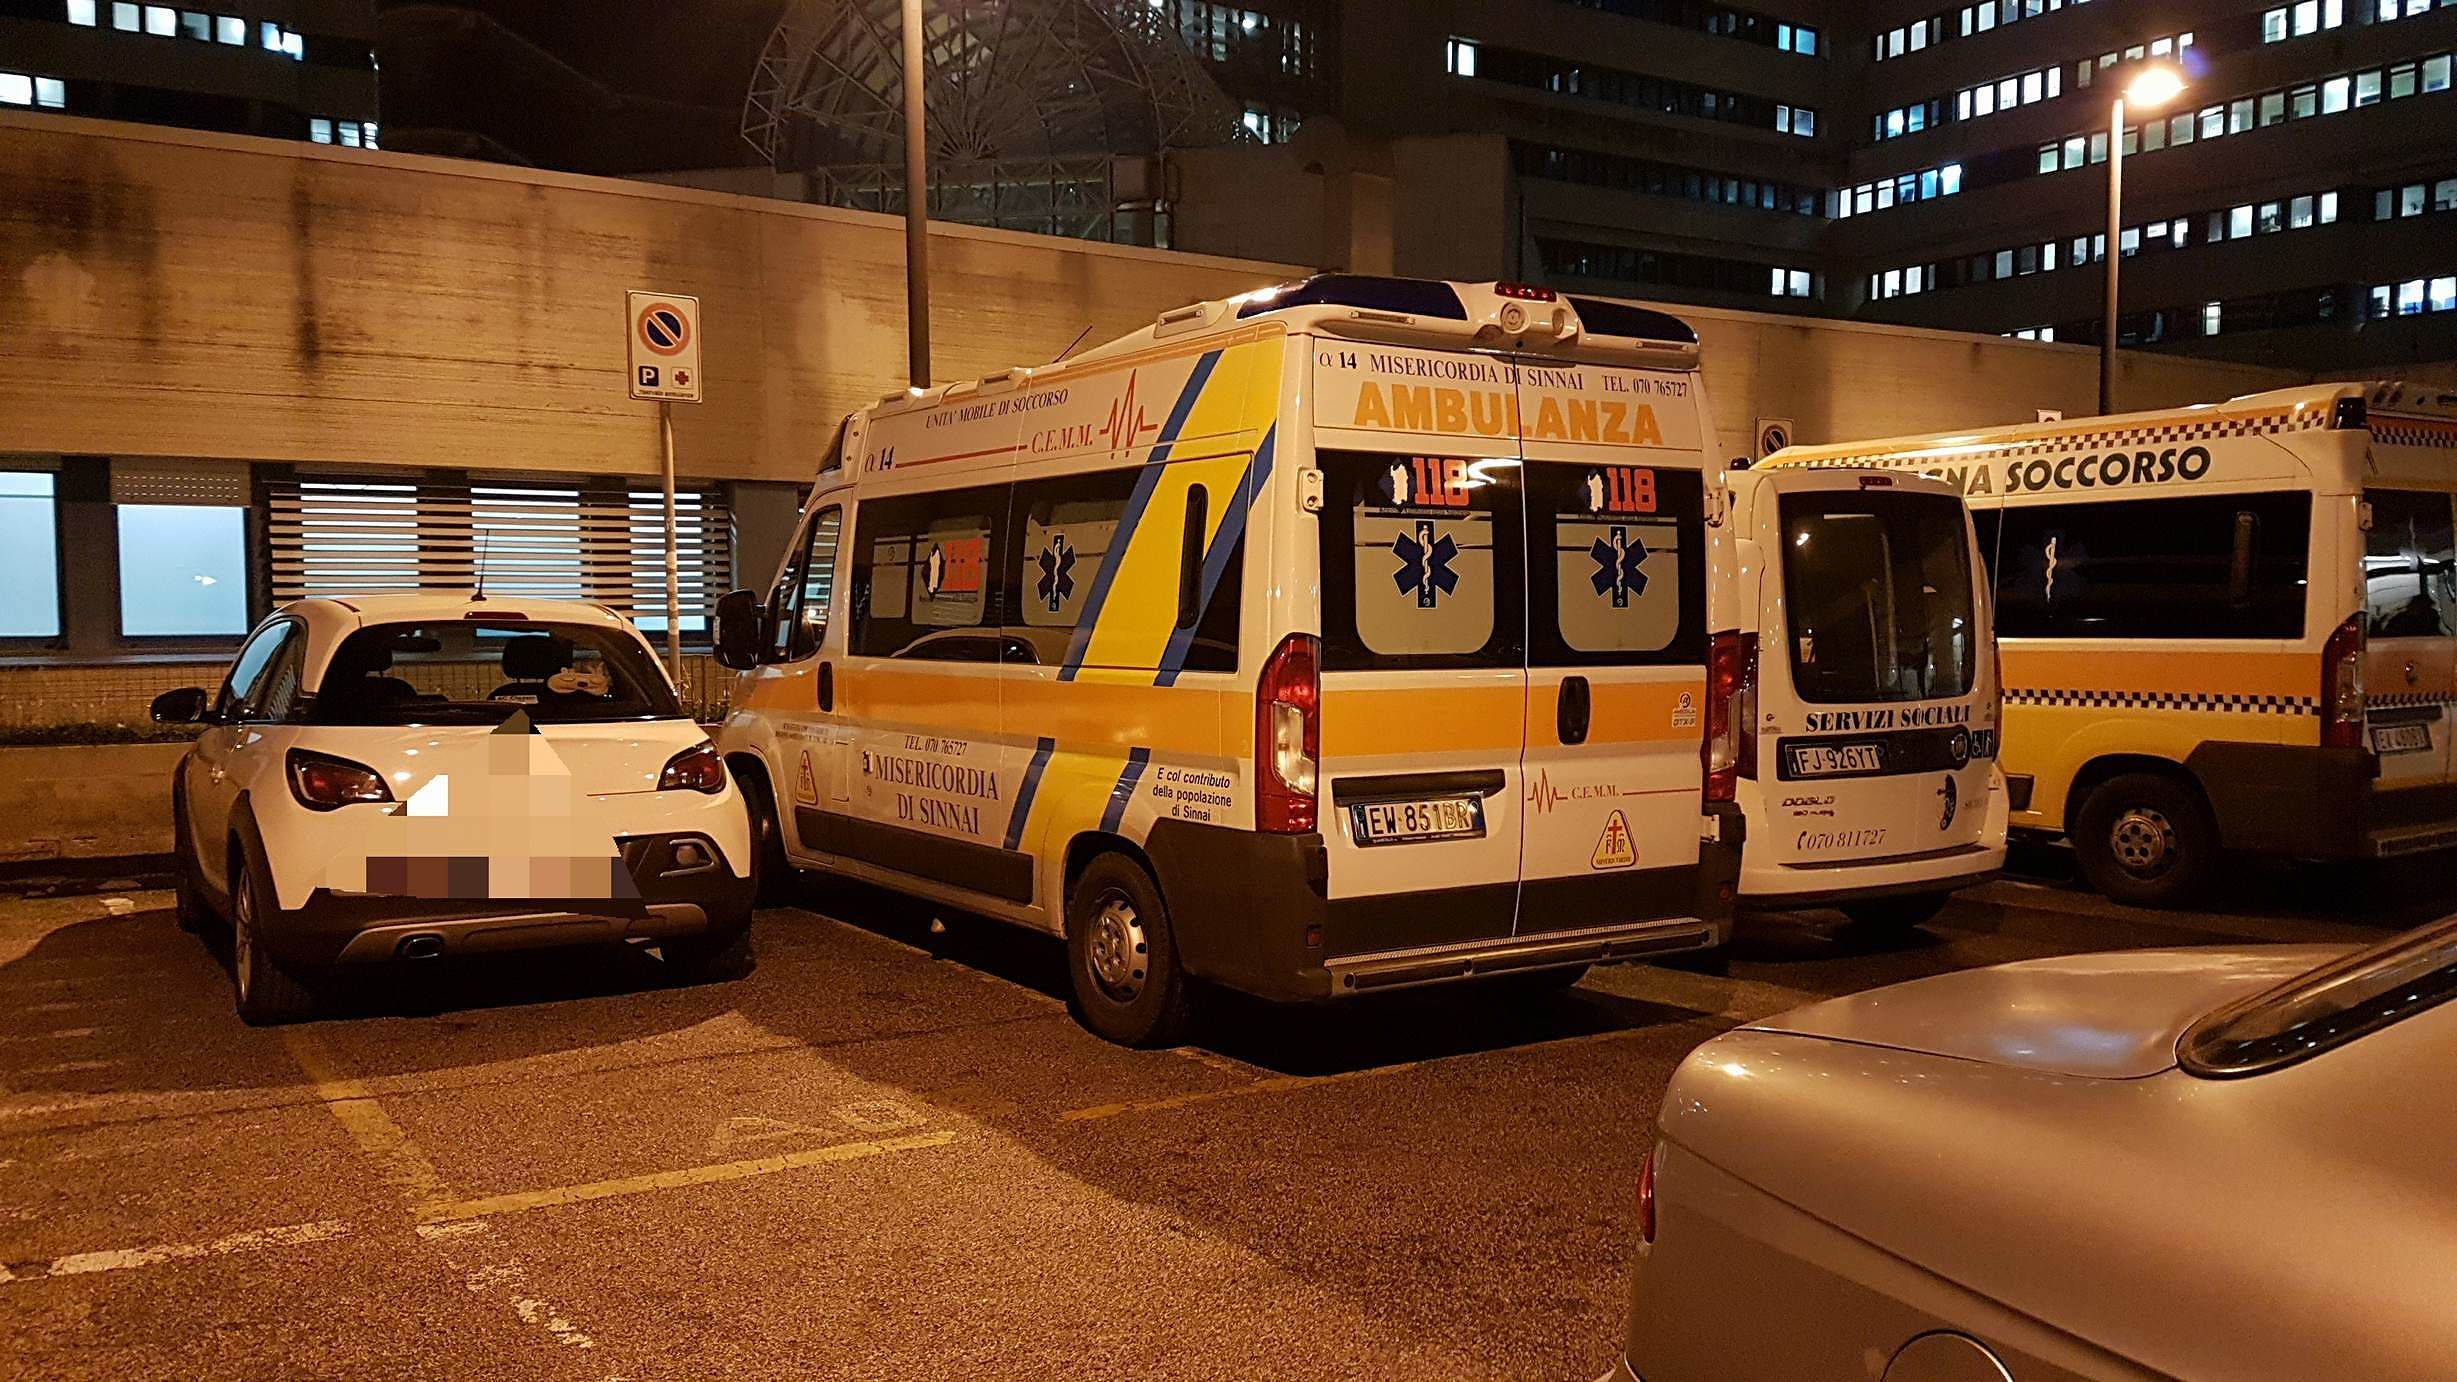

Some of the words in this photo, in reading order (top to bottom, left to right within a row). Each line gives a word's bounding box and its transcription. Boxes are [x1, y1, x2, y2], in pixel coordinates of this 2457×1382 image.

[642, 368, 655, 384] P
[1339, 351, 1357, 369] 14
[1370, 354, 1498, 382] MISERICORDIA
[1504, 367, 1521, 385] DI
[1528, 368, 1584, 390] SINNAI
[1602, 375, 1629, 392] TEL.
[1633, 378, 1650, 394] 070
[1654, 380, 1687, 397] 765727
[960, 403, 996, 422] MOBILE
[999, 400, 1012, 416] DI
[1012, 388, 1069, 413] SOCCORSO
[1354, 381, 1664, 445] AMBULANZA
[1032, 424, 1093, 454] C.E.M.M.
[879, 446, 895, 471] 14
[2005, 446, 2211, 493] SOCCORSO
[1412, 457, 1470, 506] 118
[1606, 467, 1657, 512] 118
[1806, 710, 1894, 732] SERVIZI
[1900, 704, 1970, 728] SOCIALI
[905, 735, 922, 750] TEL.
[925, 738, 938, 753] 070
[941, 739, 967, 756] 765727
[875, 755, 1000, 800] MISERICORDIA
[1157, 767, 1164, 780] E
[1167, 769, 1181, 782] col
[1183, 772, 1230, 789] contributo
[1571, 784, 1620, 799] C.E.M.M.
[1152, 784, 1173, 798] della
[1176, 790, 1232, 807] popolazione
[896, 793, 914, 821] DI
[920, 798, 979, 835] SINNAI
[1171, 804, 1180, 817] di
[1183, 805, 1211, 822] Sinnai
[1807, 832, 1834, 849] 070
[1836, 828, 1887, 848] 811727
